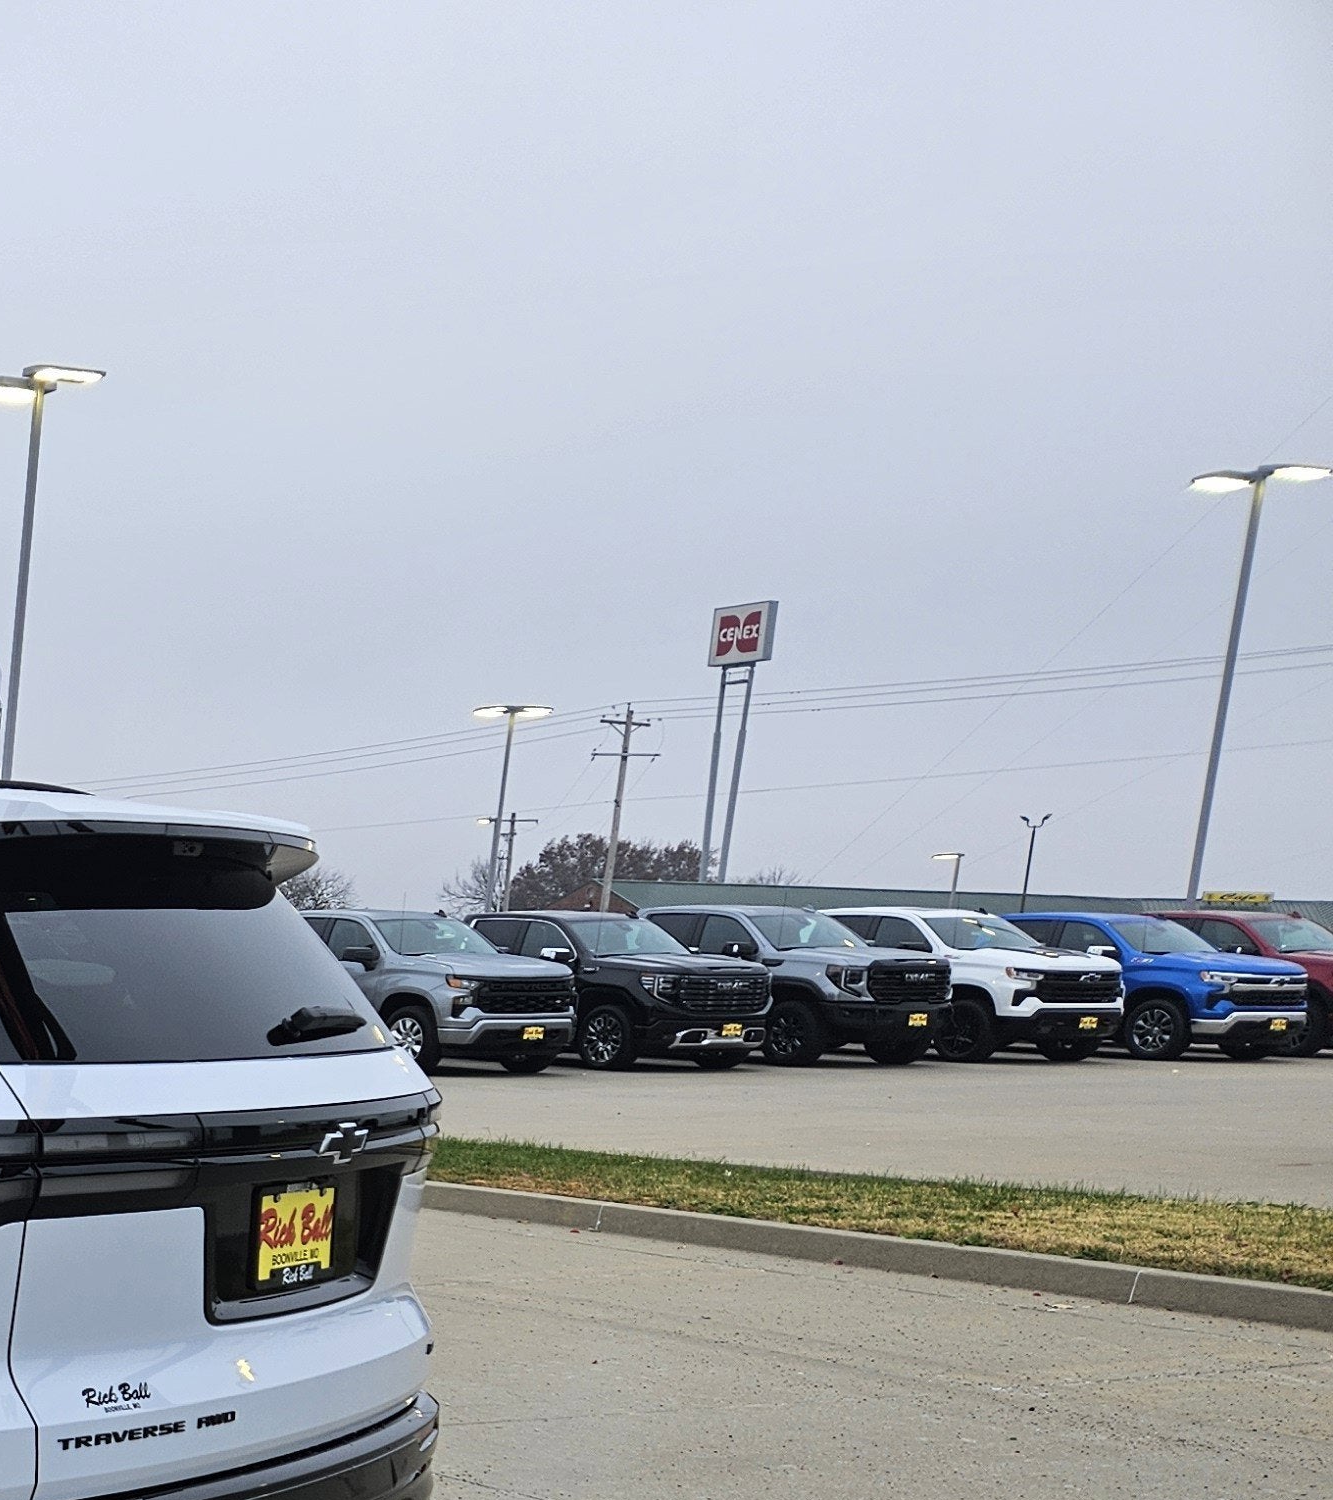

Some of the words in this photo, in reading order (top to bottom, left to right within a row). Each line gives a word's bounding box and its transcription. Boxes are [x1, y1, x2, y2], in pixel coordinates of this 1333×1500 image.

[719, 624, 759, 643] CENEX
[260, 1208, 296, 1249] Rick
[301, 1203, 333, 1245] Ball
[82, 1386, 118, 1408] Rick
[118, 1382, 151, 1401] Ball
[58, 1421, 186, 1450] TRAVERSE
[197, 1411, 236, 1429] AWD
